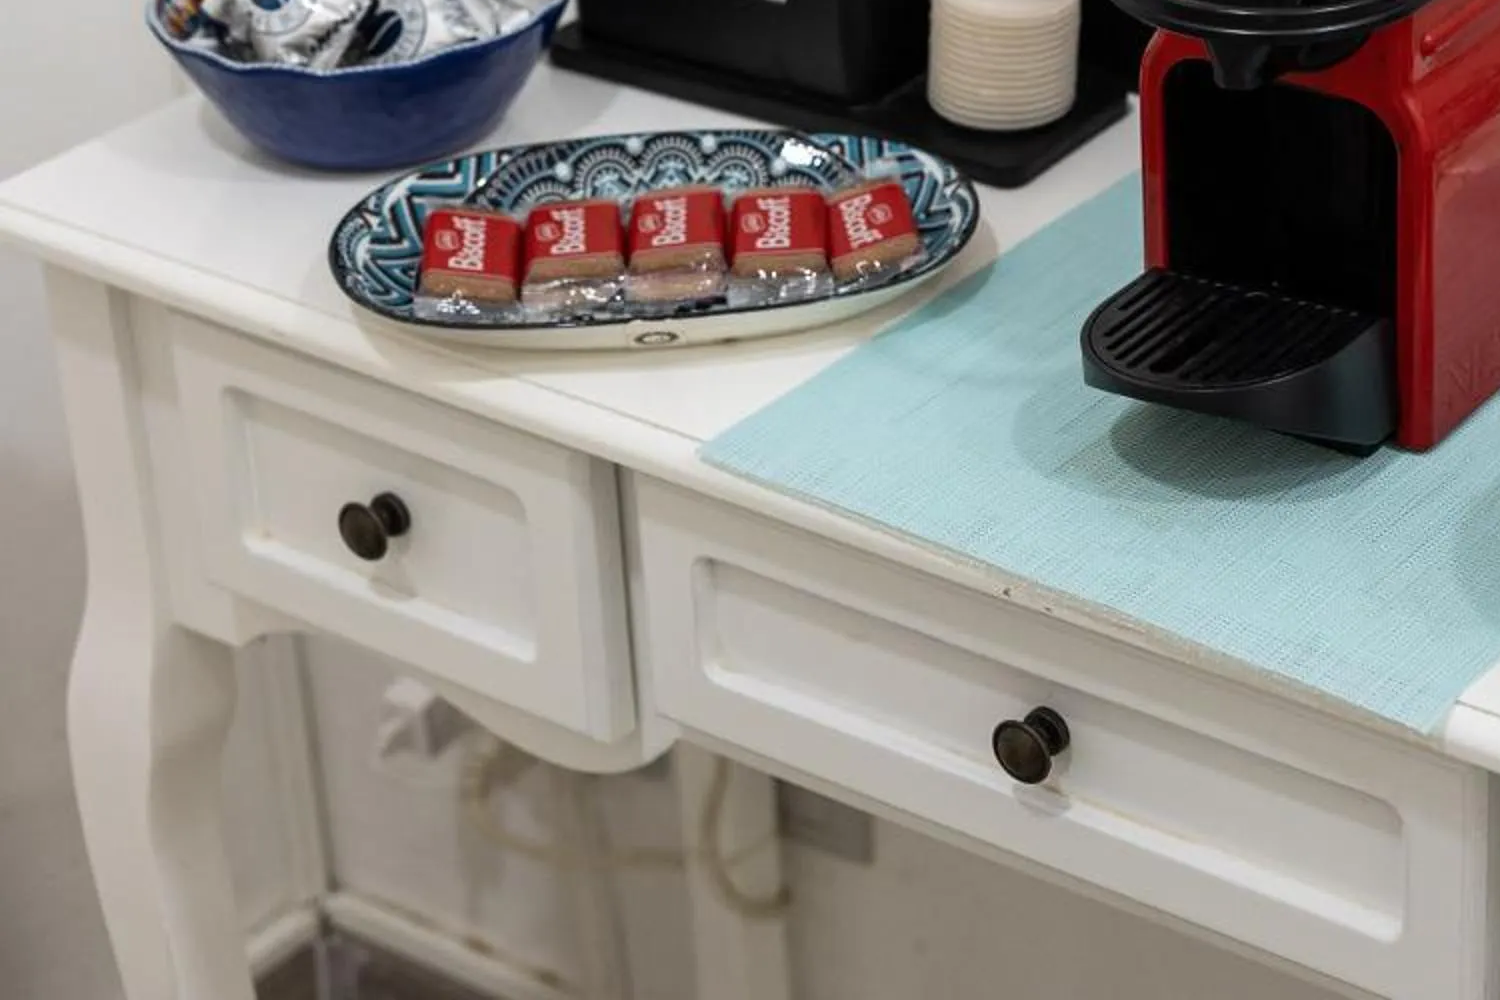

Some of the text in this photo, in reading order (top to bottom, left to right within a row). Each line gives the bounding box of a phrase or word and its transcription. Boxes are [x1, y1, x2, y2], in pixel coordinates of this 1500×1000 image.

[448, 216, 487, 271] Biscoff
[550, 208, 586, 255] Biscoff
[651, 197, 687, 247] Biscoff
[755, 197, 791, 248] Biscoff
[839, 193, 883, 248] Biscoff
